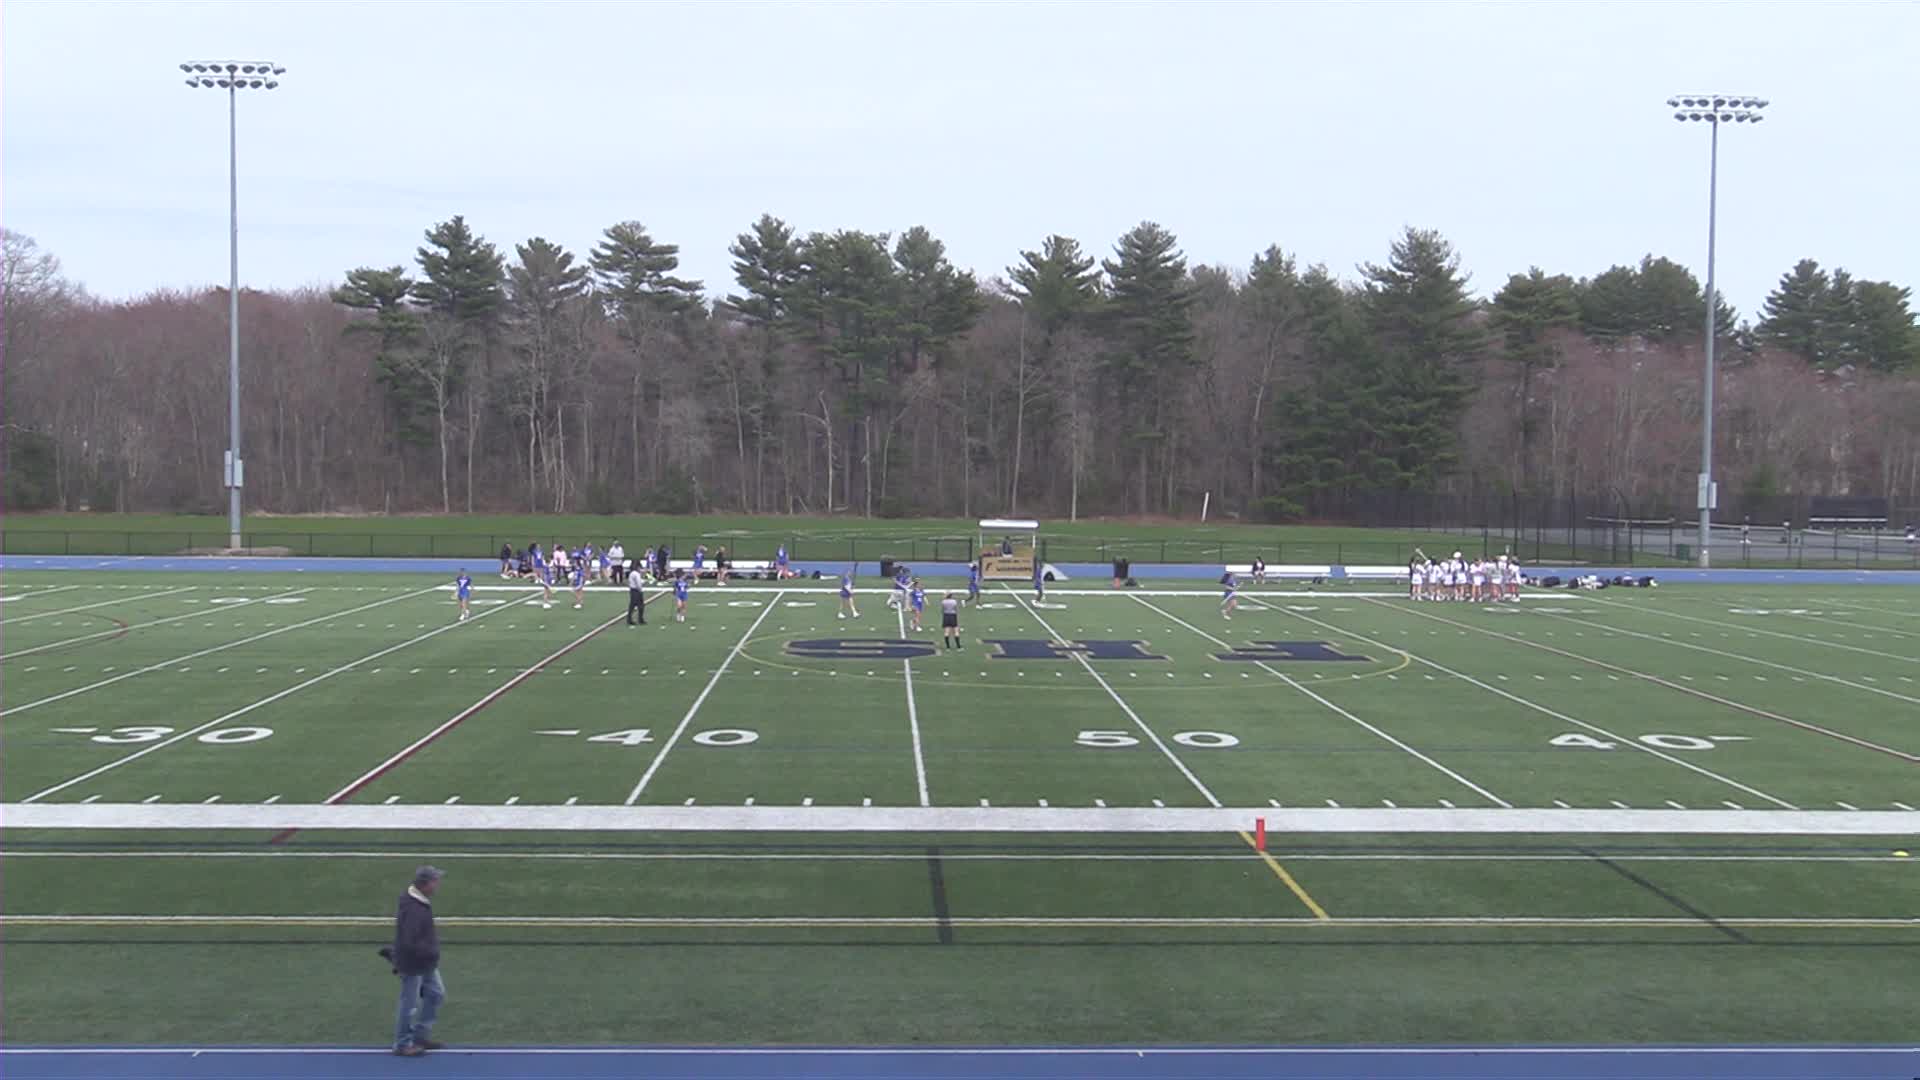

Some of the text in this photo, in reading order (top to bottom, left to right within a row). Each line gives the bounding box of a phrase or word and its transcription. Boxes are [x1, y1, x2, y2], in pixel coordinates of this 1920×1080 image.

[91, 726, 274, 744] 30
[587, 728, 760, 746] 40
[1075, 730, 1241, 748] 50
[1549, 733, 1715, 750] 40
